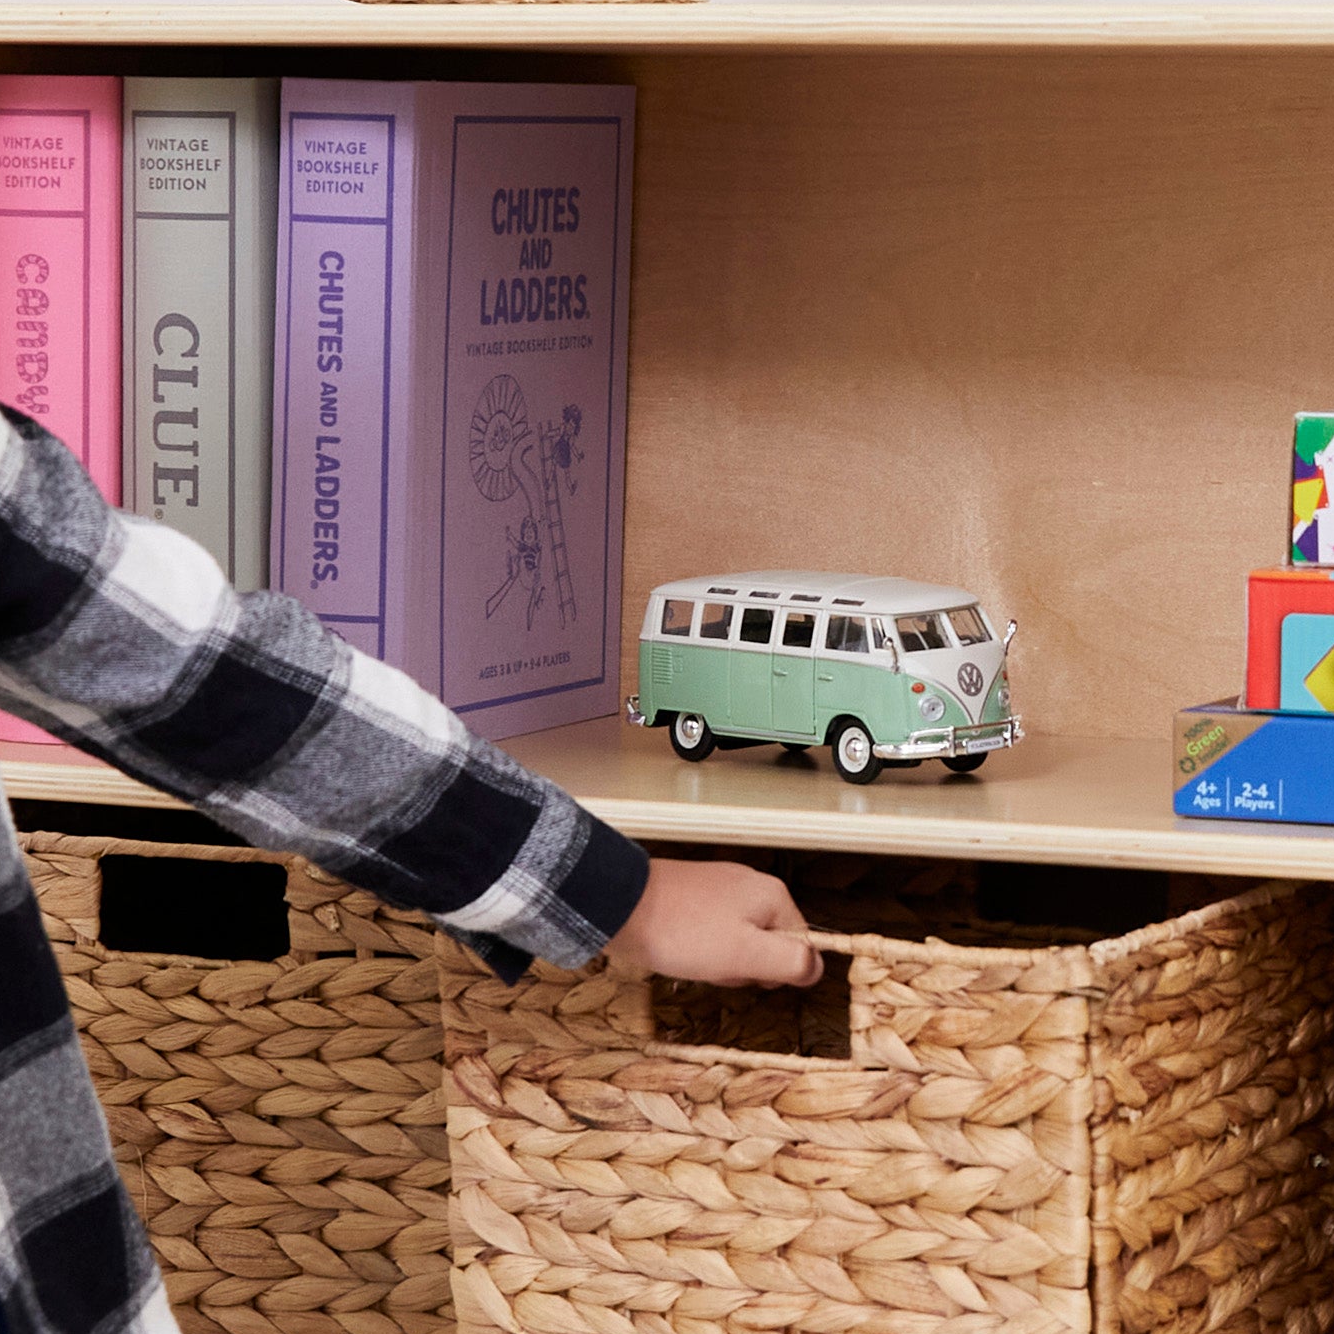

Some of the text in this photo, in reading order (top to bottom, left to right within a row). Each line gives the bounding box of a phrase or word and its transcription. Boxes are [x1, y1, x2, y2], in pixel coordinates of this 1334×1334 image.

[2, 137, 64, 151] VINTAGE
[146, 139, 210, 152] VINTAGE
[304, 140, 367, 155] VINTAGE
[140, 158, 222, 172] BOOKSHELF
[296, 160, 379, 175] BOOKSHELF
[5, 175, 61, 189] EDITION
[148, 178, 207, 191] EDITION
[306, 180, 364, 194] EDITION
[491, 186, 581, 235] CHUTES
[519, 237, 553, 270] AND
[317, 250, 345, 374] CHUTES
[466, 334, 594, 357] VINTAGE BOOKSHELF EDITION
[152, 312, 201, 508] CLUE
[320, 381, 338, 428] AND
[1187, 725, 1225, 756] Green
[1196, 780, 1218, 796] 4+
[1242, 782, 1268, 798] 2-4
[1193, 794, 1222, 810] Ages
[1234, 796, 1276, 812] Players
